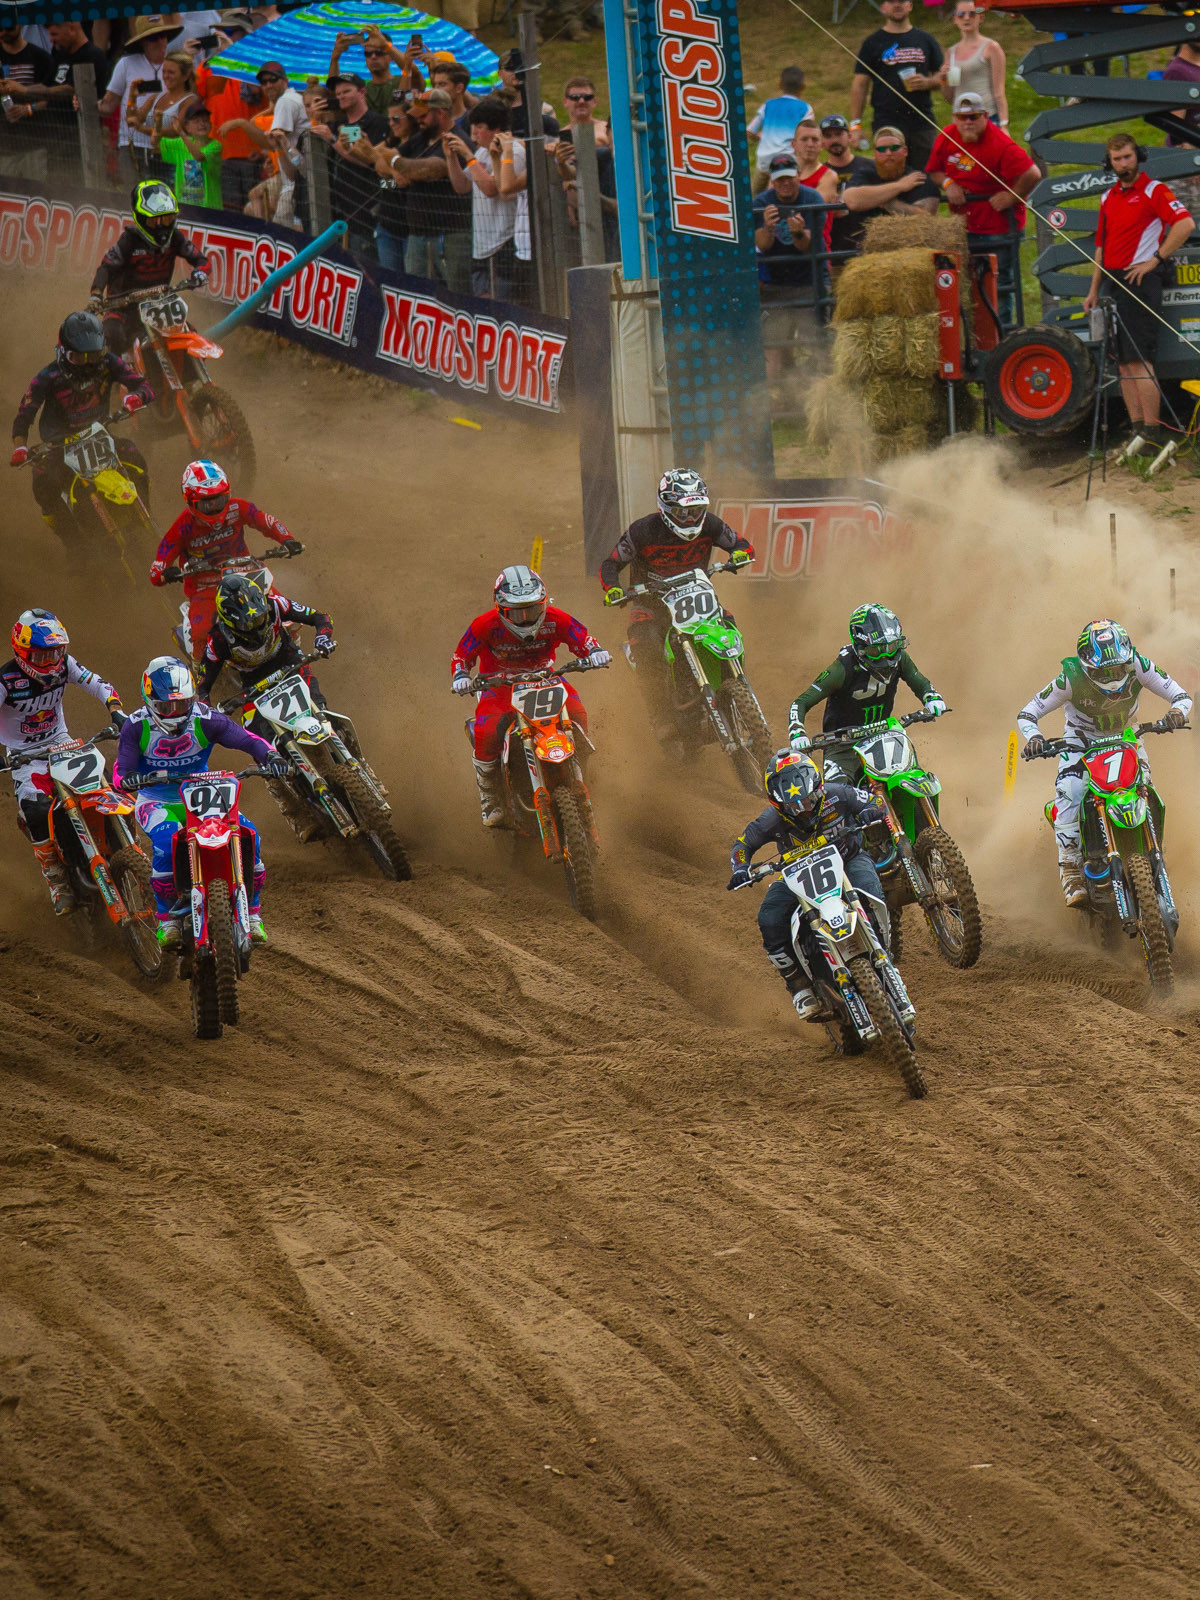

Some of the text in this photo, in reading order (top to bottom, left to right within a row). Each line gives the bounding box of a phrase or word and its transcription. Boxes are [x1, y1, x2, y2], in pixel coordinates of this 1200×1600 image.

[146, 305, 187, 328] 319
[673, 592, 714, 624] 80
[271, 684, 312, 723] 21
[518, 686, 564, 721] 19
[67, 753, 100, 789] 2
[146, 757, 203, 768] HONDA
[863, 737, 906, 772] 17
[1103, 750, 1125, 785] 1
[189, 786, 233, 817] 94
[796, 857, 838, 900] 16
[884, 966, 908, 1004] DUNLOP
